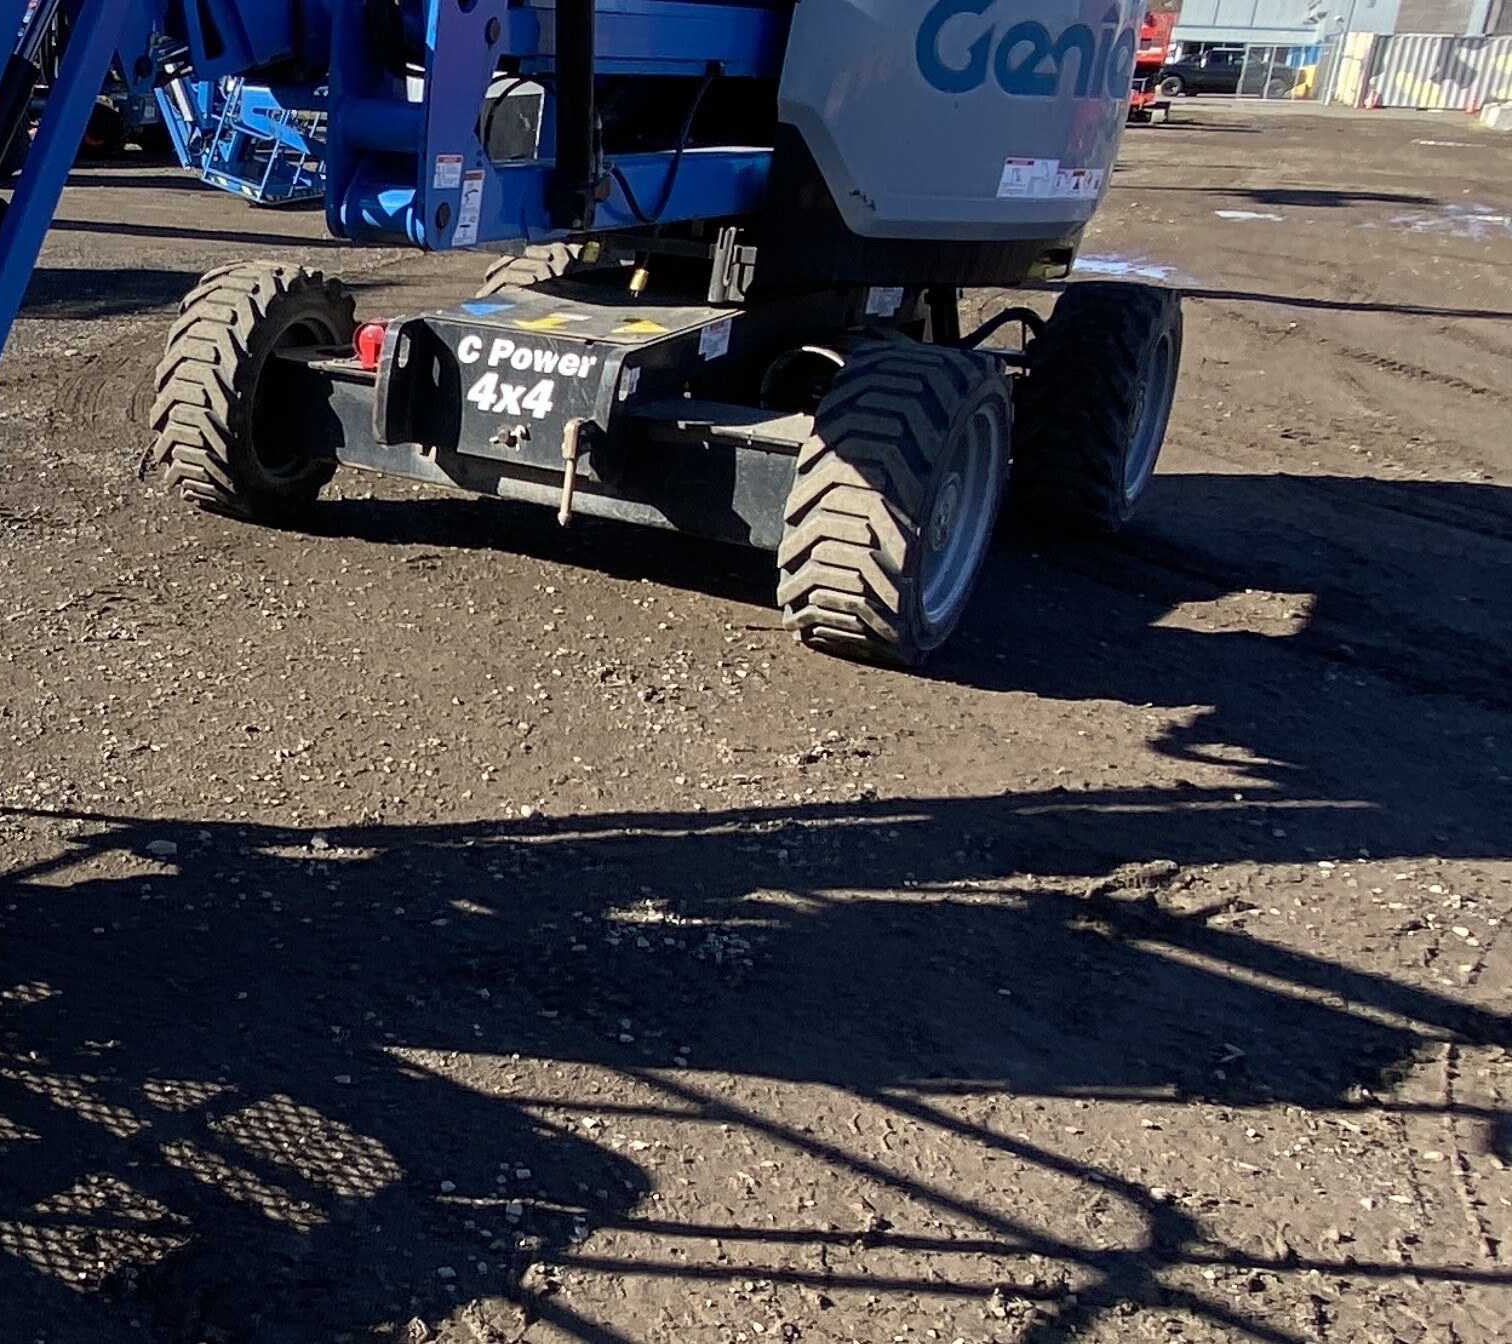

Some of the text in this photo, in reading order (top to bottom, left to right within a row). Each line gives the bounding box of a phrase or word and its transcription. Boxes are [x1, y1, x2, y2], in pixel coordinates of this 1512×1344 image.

[458, 335, 598, 379] C Power
[467, 371, 555, 420] 4x4
